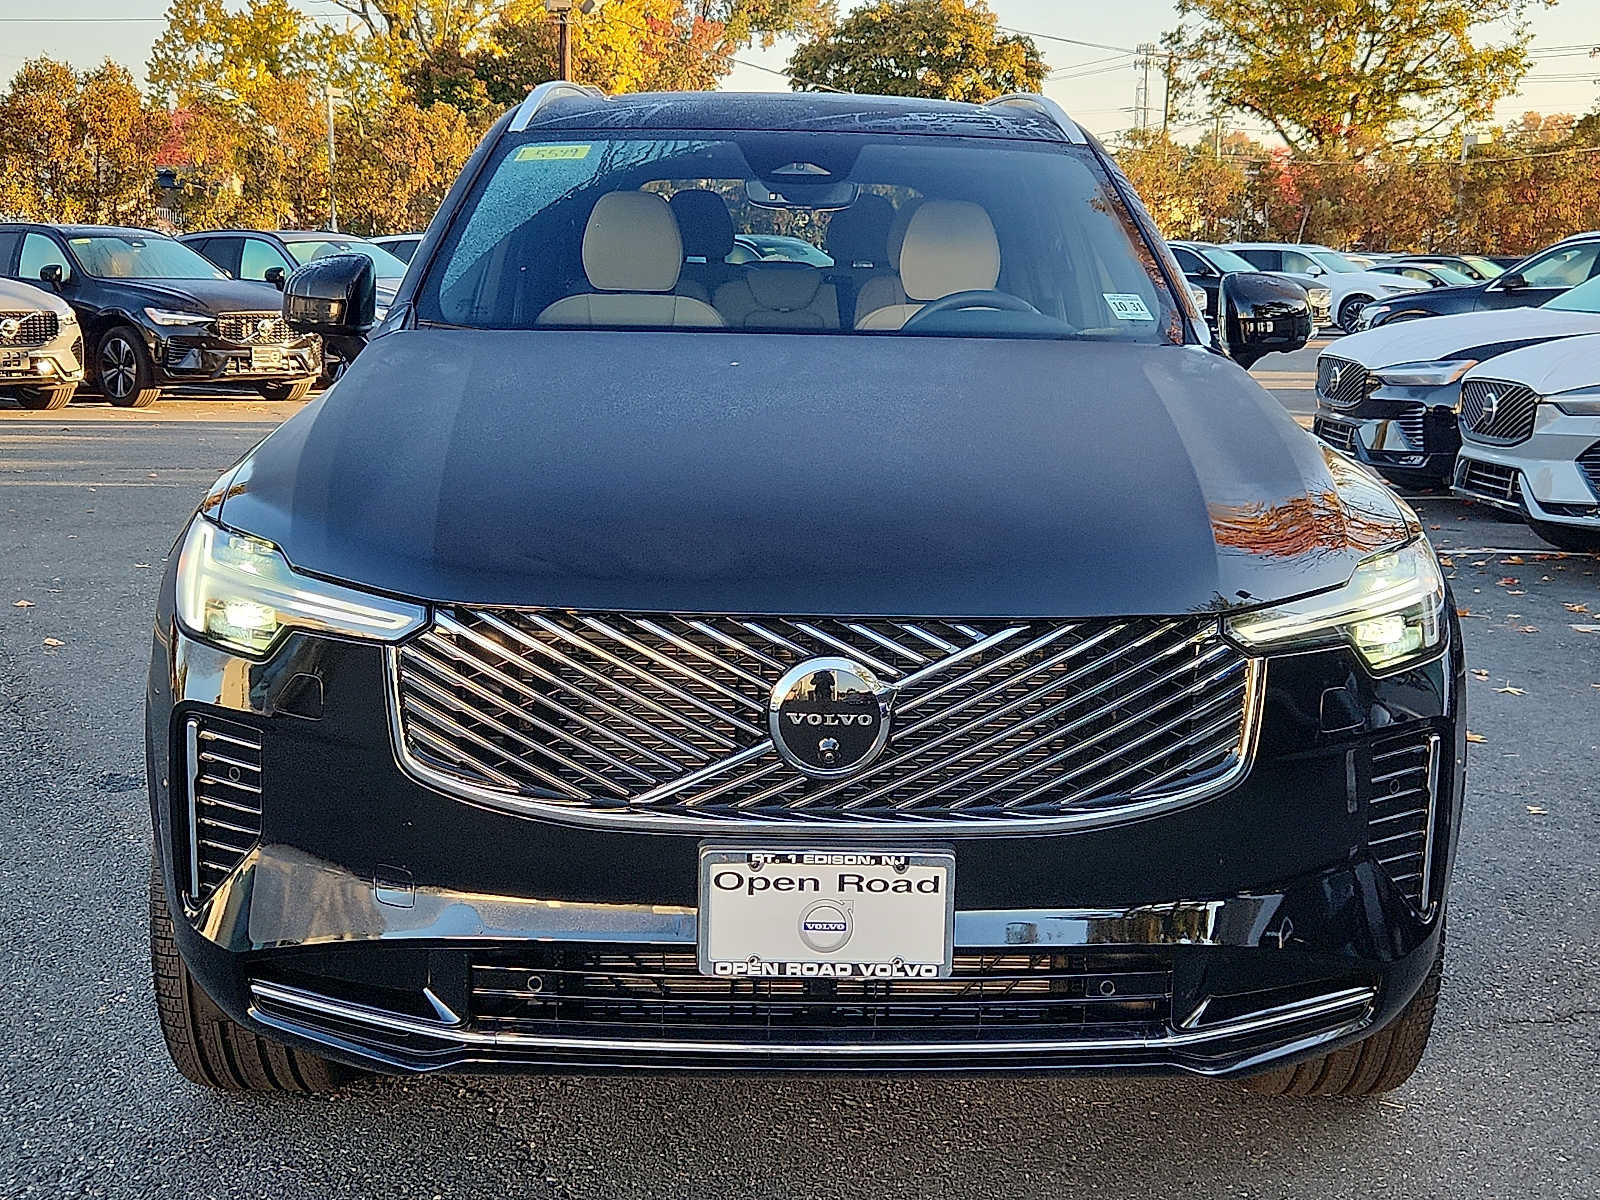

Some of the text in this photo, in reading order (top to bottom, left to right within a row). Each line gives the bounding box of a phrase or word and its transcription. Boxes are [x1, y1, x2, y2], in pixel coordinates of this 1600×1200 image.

[1113, 301, 1145, 311] 10 31
[786, 712, 873, 726] VOLVO
[787, 853, 797, 865] 1
[803, 854, 876, 866] EDISON,
[881, 854, 906, 866] NJ
[713, 871, 941, 896] Open Road
[805, 923, 846, 931] VOLVO
[714, 962, 939, 978] OPEN ROAD VOLVO
